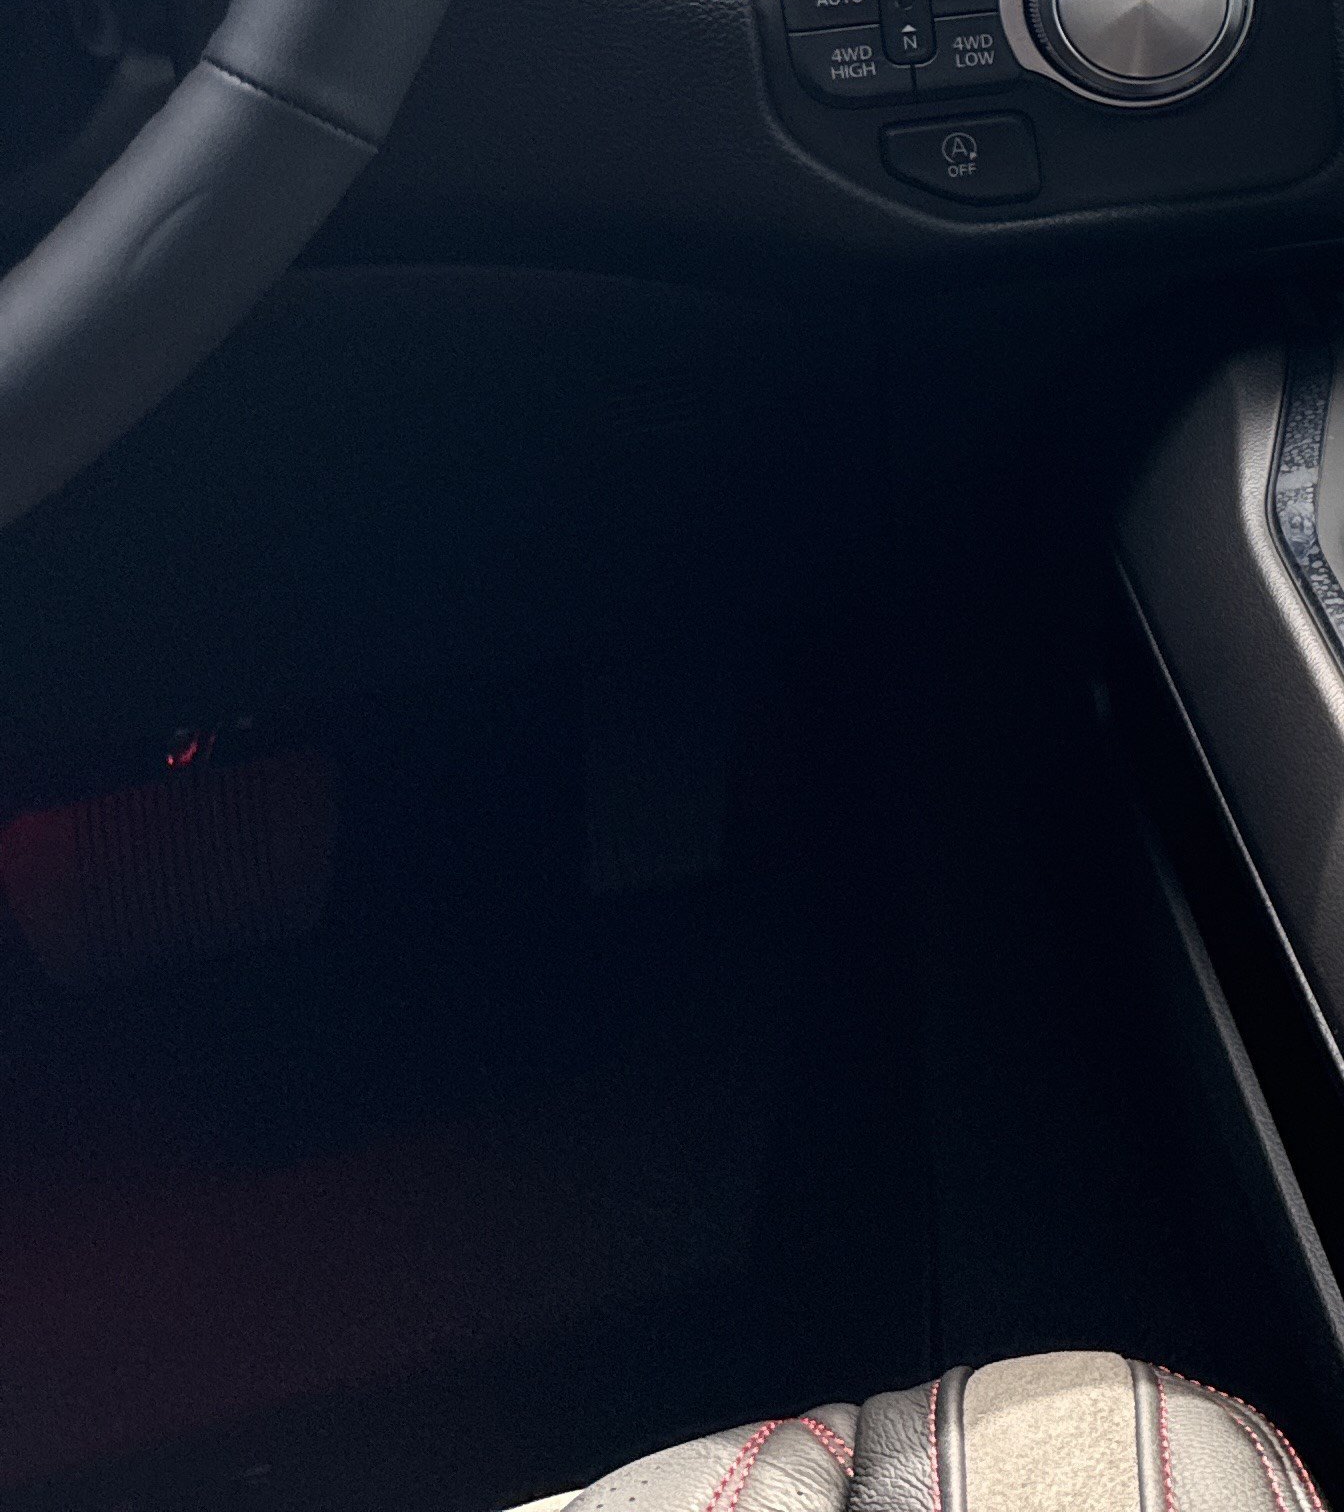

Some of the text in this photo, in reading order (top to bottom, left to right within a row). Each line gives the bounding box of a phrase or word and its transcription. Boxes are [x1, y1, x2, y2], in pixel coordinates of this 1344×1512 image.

[903, 35, 917, 50] N
[952, 34, 993, 51] 4WD
[831, 45, 873, 63] 4WD
[955, 50, 995, 68] LOW
[831, 61, 876, 80] HIGH
[948, 162, 976, 177] OFF
